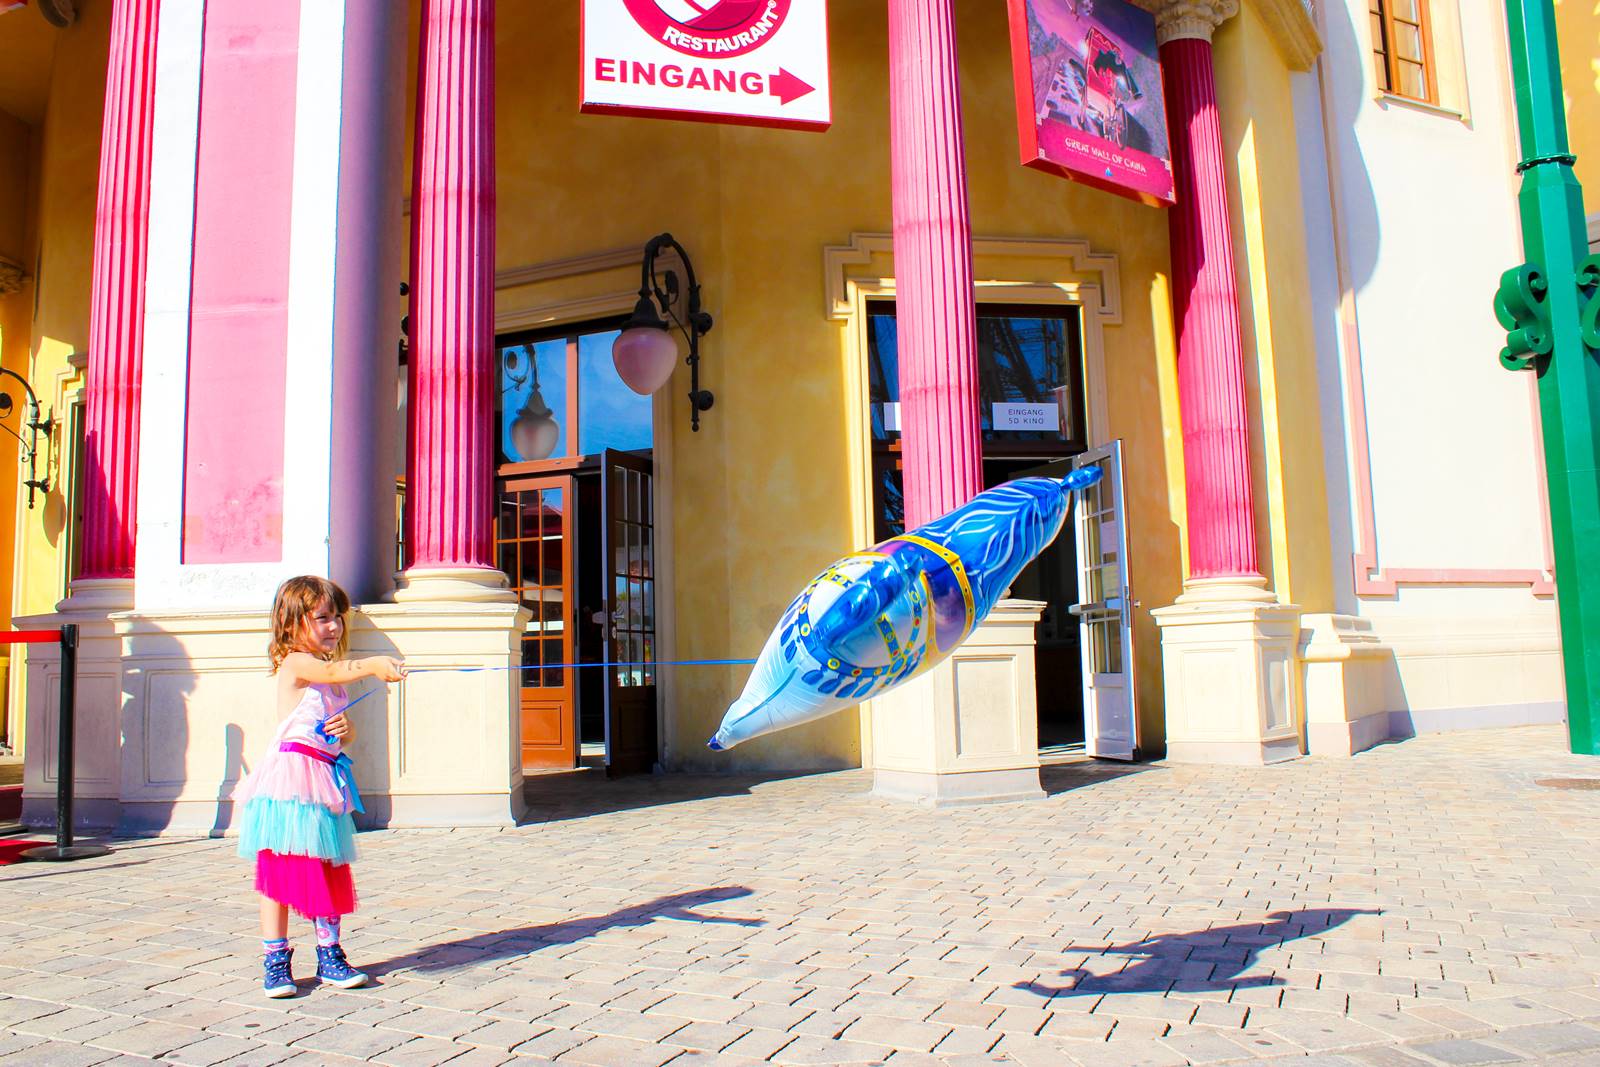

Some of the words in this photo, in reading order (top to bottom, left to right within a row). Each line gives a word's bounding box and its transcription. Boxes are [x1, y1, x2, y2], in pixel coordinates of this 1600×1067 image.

[595, 57, 764, 95] EINGANG
[1065, 137, 1089, 153] GREAT
[1091, 147, 1110, 161] WALL
[1111, 154, 1123, 164] OF
[1008, 408, 1044, 416] EINGANG
[1008, 417, 1020, 425] 5D
[1023, 417, 1044, 425] KINO
